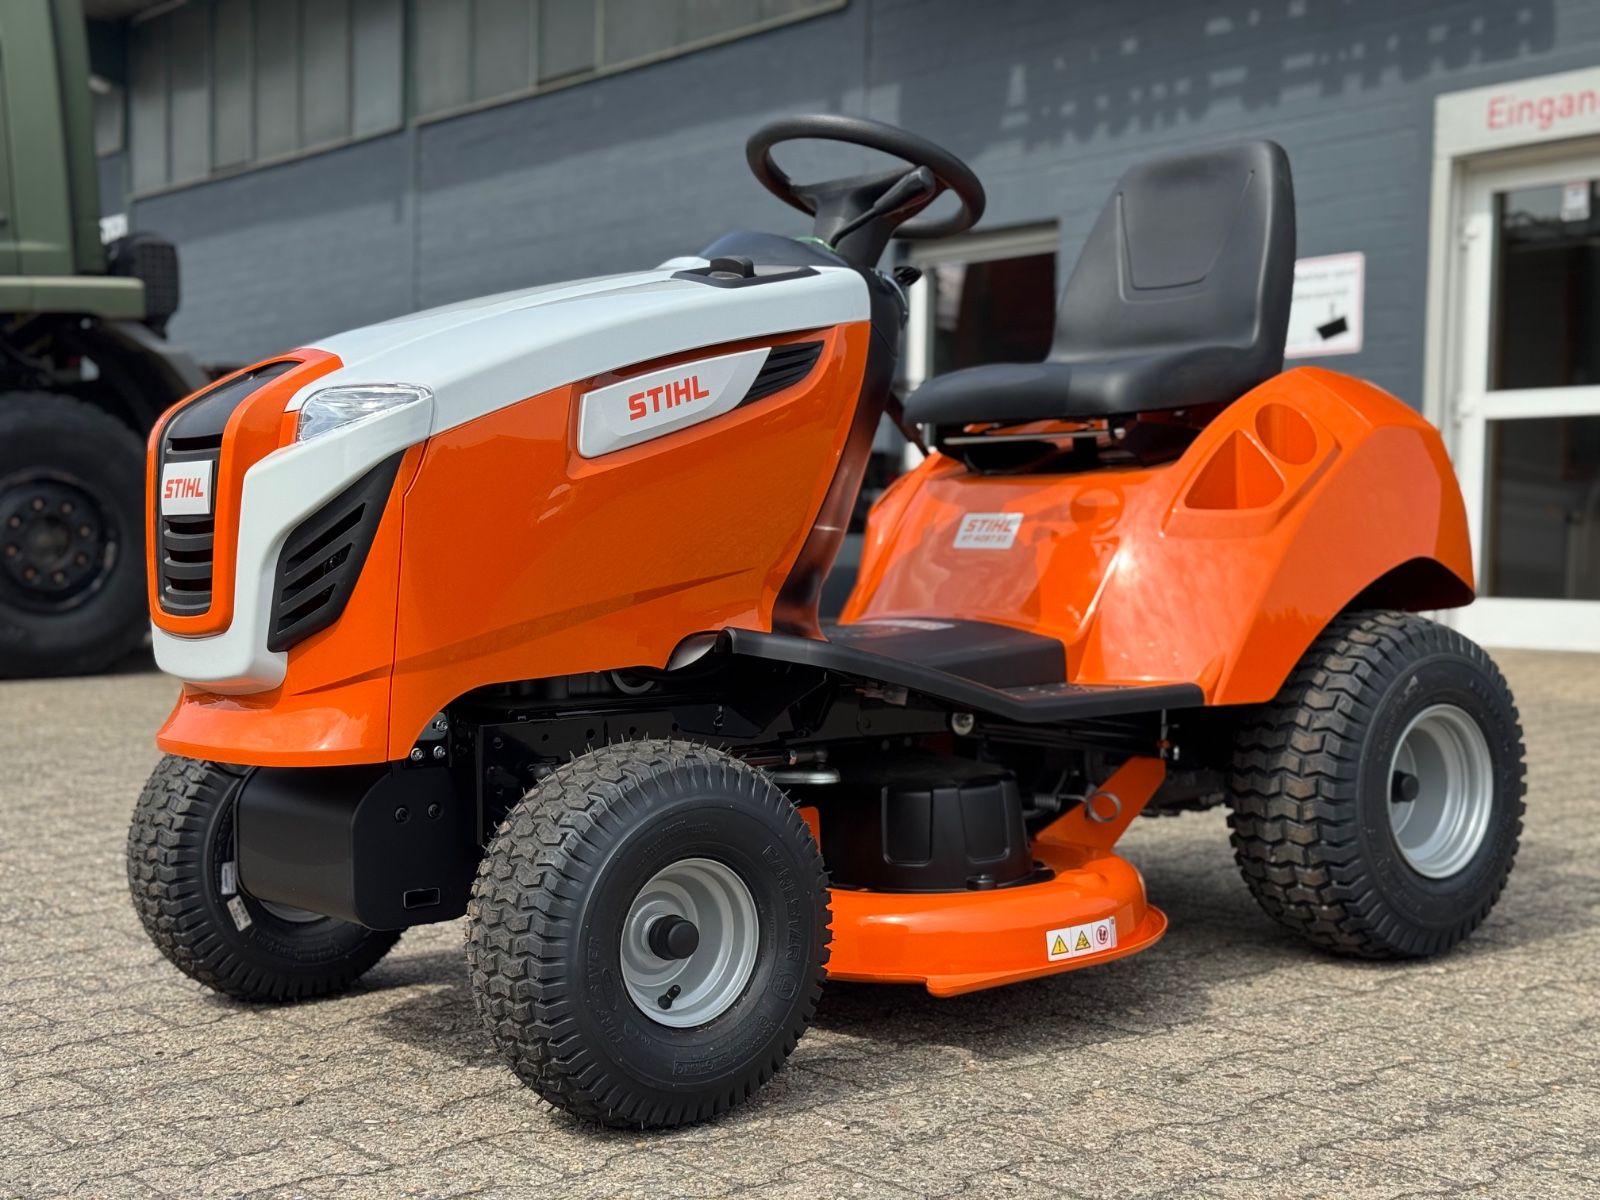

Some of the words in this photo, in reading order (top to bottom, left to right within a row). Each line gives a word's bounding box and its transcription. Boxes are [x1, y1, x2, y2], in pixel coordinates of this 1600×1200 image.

[1487, 89, 1600, 130] Eingan
[628, 375, 710, 421] STIHL
[164, 478, 204, 498] STIHL
[964, 518, 1013, 533] STIHL
